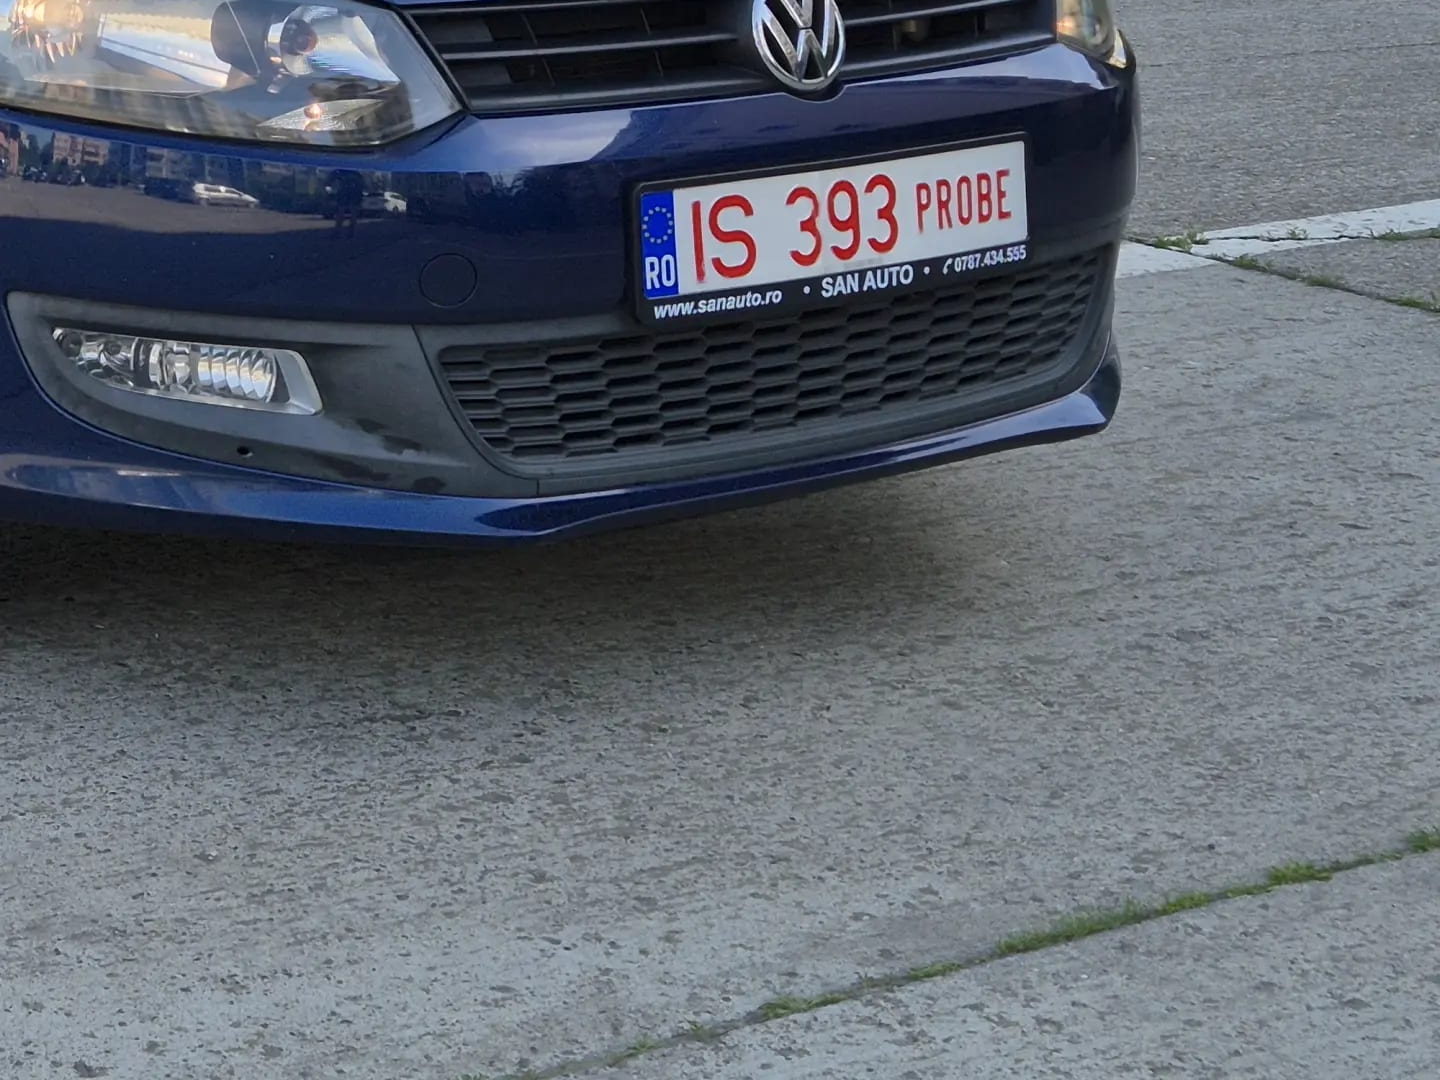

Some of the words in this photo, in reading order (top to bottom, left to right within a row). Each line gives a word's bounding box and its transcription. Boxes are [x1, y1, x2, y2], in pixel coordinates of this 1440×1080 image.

[691, 194, 757, 284] IS
[786, 173, 899, 267] 393
[914, 168, 1013, 235] PROBE
[645, 254, 677, 290] RO
[653, 288, 783, 320] www.sanauto.ro
[820, 275, 860, 299] SAN
[863, 264, 914, 292] AUTO
